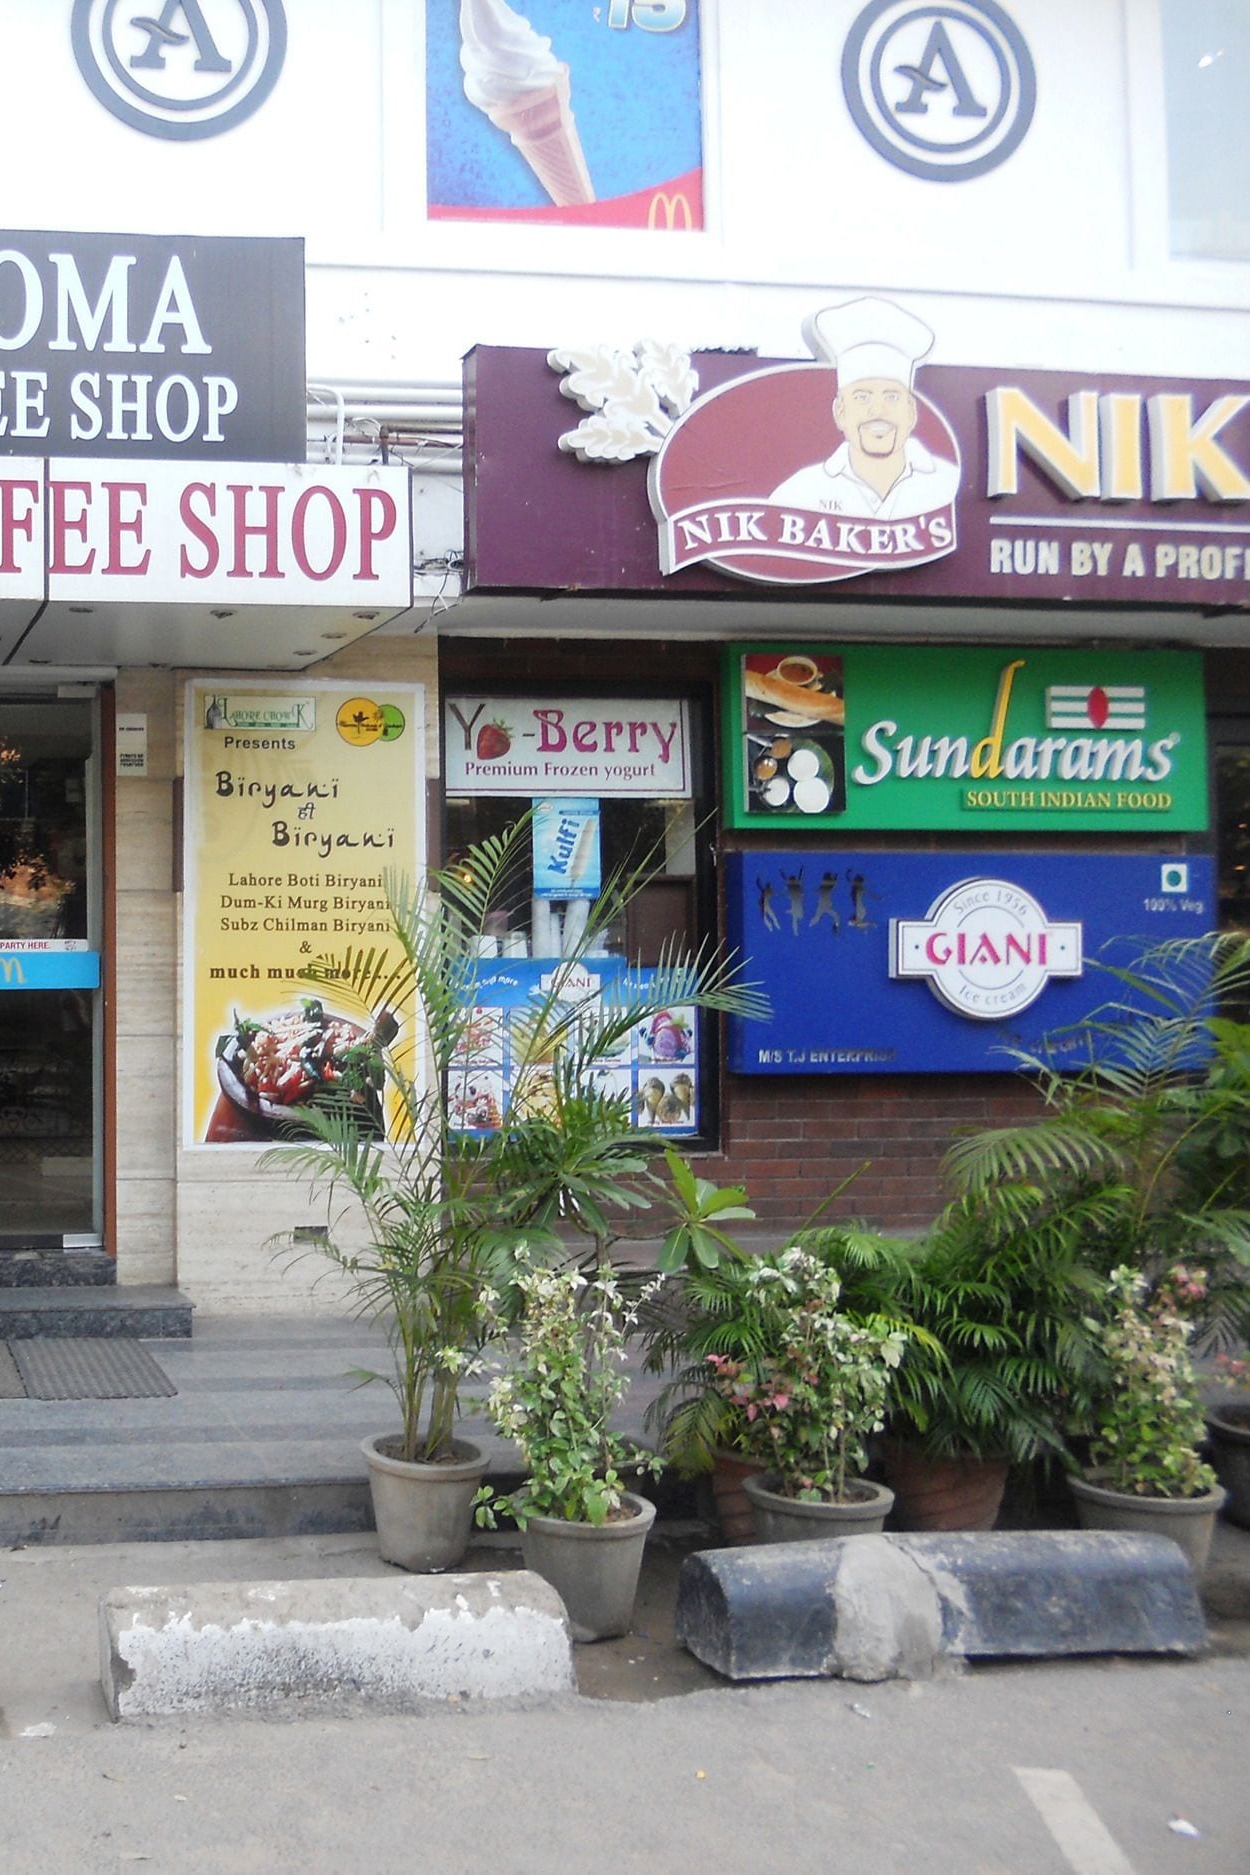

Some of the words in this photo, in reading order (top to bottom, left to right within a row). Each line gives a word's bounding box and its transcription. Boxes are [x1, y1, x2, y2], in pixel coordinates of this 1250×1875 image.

[70, 372, 238, 442] SHOP
[986, 386, 1250, 501] NIK
[819, 499, 843, 512] NIK
[180, 482, 397, 580] SHOP
[678, 511, 767, 550] NIK
[778, 515, 952, 554] BAKER'S
[990, 538, 1059, 576] RUN
[1071, 541, 1113, 576] BY
[1122, 542, 1146, 578] A
[852, 660, 1177, 785] Sundarams
[224, 736, 296, 750] Presents
[465, 761, 538, 776] Premium
[544, 762, 598, 776] Frozen
[604, 763, 656, 781] yogurt
[966, 790, 1036, 808] SOUTH
[1041, 791, 1112, 809] INDIAN
[1116, 791, 1172, 809] FOOD
[547, 818, 580, 874] Kulfi
[229, 873, 282, 887] Lahore
[287, 873, 320, 887] Boti
[325, 874, 382, 891] Biryani
[221, 895, 282, 909] Dum-Ki
[287, 896, 328, 912] Murg
[333, 896, 390, 913] Biryani
[953, 892, 990, 916] Since
[997, 889, 1028, 916] 1956
[1143, 898, 1177, 911] 100%
[1180, 898, 1204, 914] Veg
[221, 918, 258, 932] Subz
[263, 918, 328, 932] Chilman
[333, 919, 390, 935] Biryani
[0, 941, 26, 950] PARTY
[299, 940, 313, 954] &
[925, 932, 1047, 966] GIANI
[210, 964, 260, 979] much
[959, 985, 980, 1002] Ice
[984, 983, 1028, 1005] cream
[758, 1048, 783, 1064] M/S
